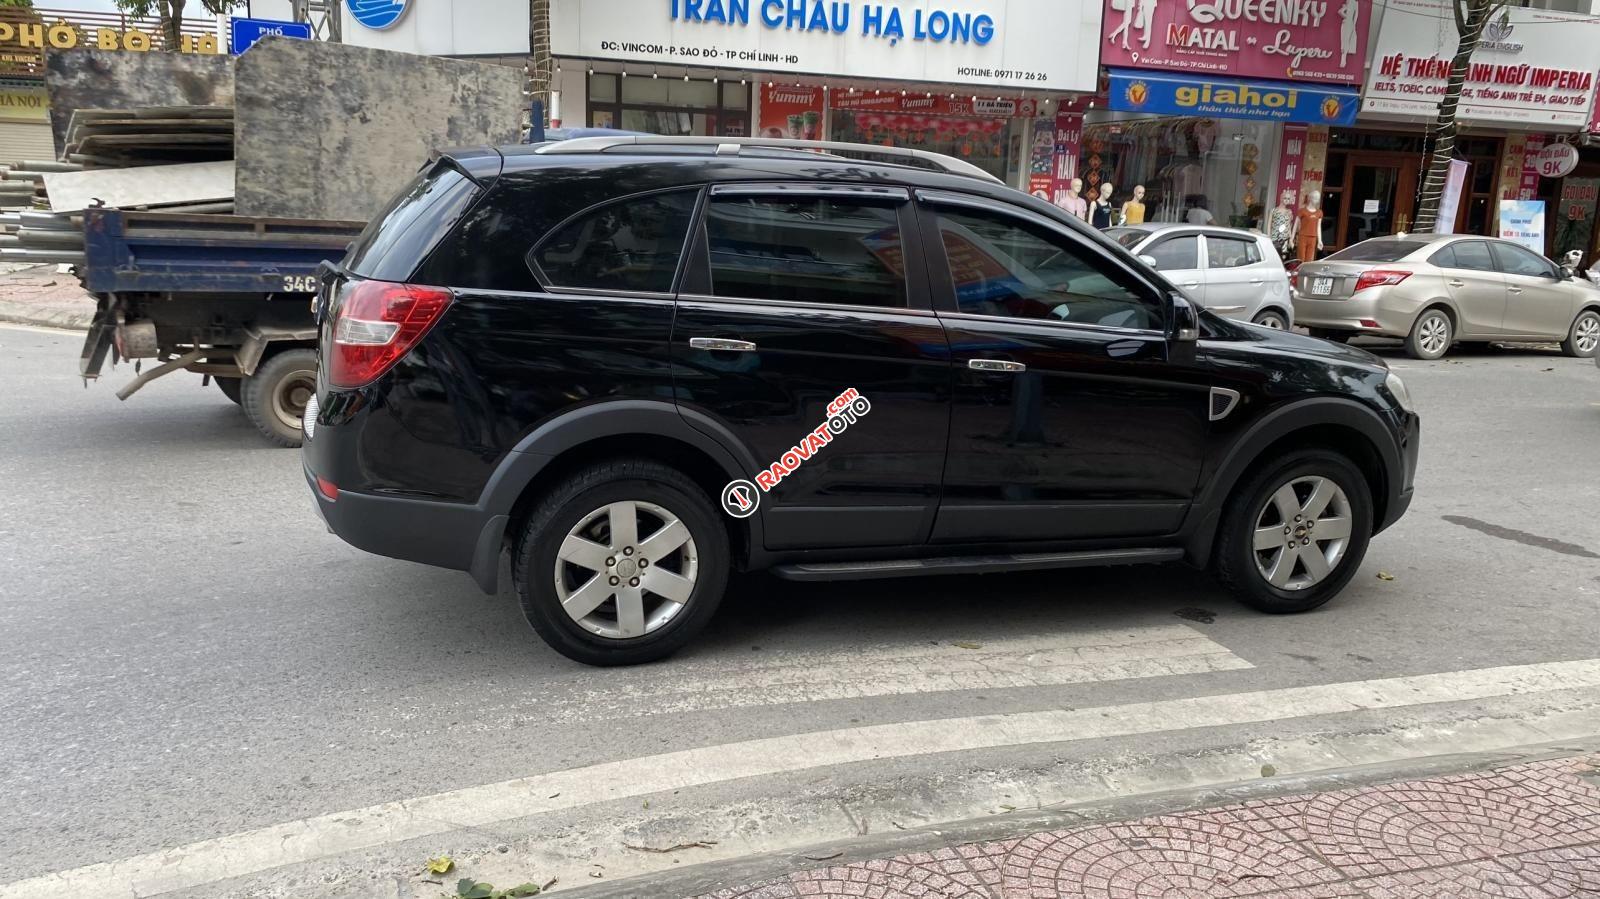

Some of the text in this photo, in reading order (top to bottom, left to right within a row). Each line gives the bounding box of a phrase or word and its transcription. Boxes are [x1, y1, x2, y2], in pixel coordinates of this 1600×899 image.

[863, 4, 905, 46] HẠ
[913, 9, 995, 46] LONG
[1166, 23, 1240, 51] MATAL
[601, 41, 620, 51] ĐC:
[622, 42, 663, 54] VINCOM
[680, 47, 700, 57] SAO
[703, 45, 718, 58] ĐỎ
[726, 50, 737, 60] TP
[739, 49, 757, 61] CHÍ
[758, 52, 779, 63] LINH
[786, 54, 799, 64] HD
[957, 67, 1048, 81] HOTLINE: 0971 17 26 26
[1380, 53, 1404, 80] HỆ
[1530, 67, 1593, 91] IMPERIA
[768, 91, 816, 107] Yummy
[901, 97, 935, 109] Yummy
[1175, 83, 1298, 109] giahoi
[1374, 82, 1397, 93] IELTS,
[1399, 83, 1424, 97] TOEIC,
[1476, 87, 1500, 100] TIẾNG
[1500, 91, 1518, 101] ANH
[1548, 95, 1568, 105] GIAO
[1543, 160, 1561, 175] 9K
[283, 275, 316, 293] 34C
